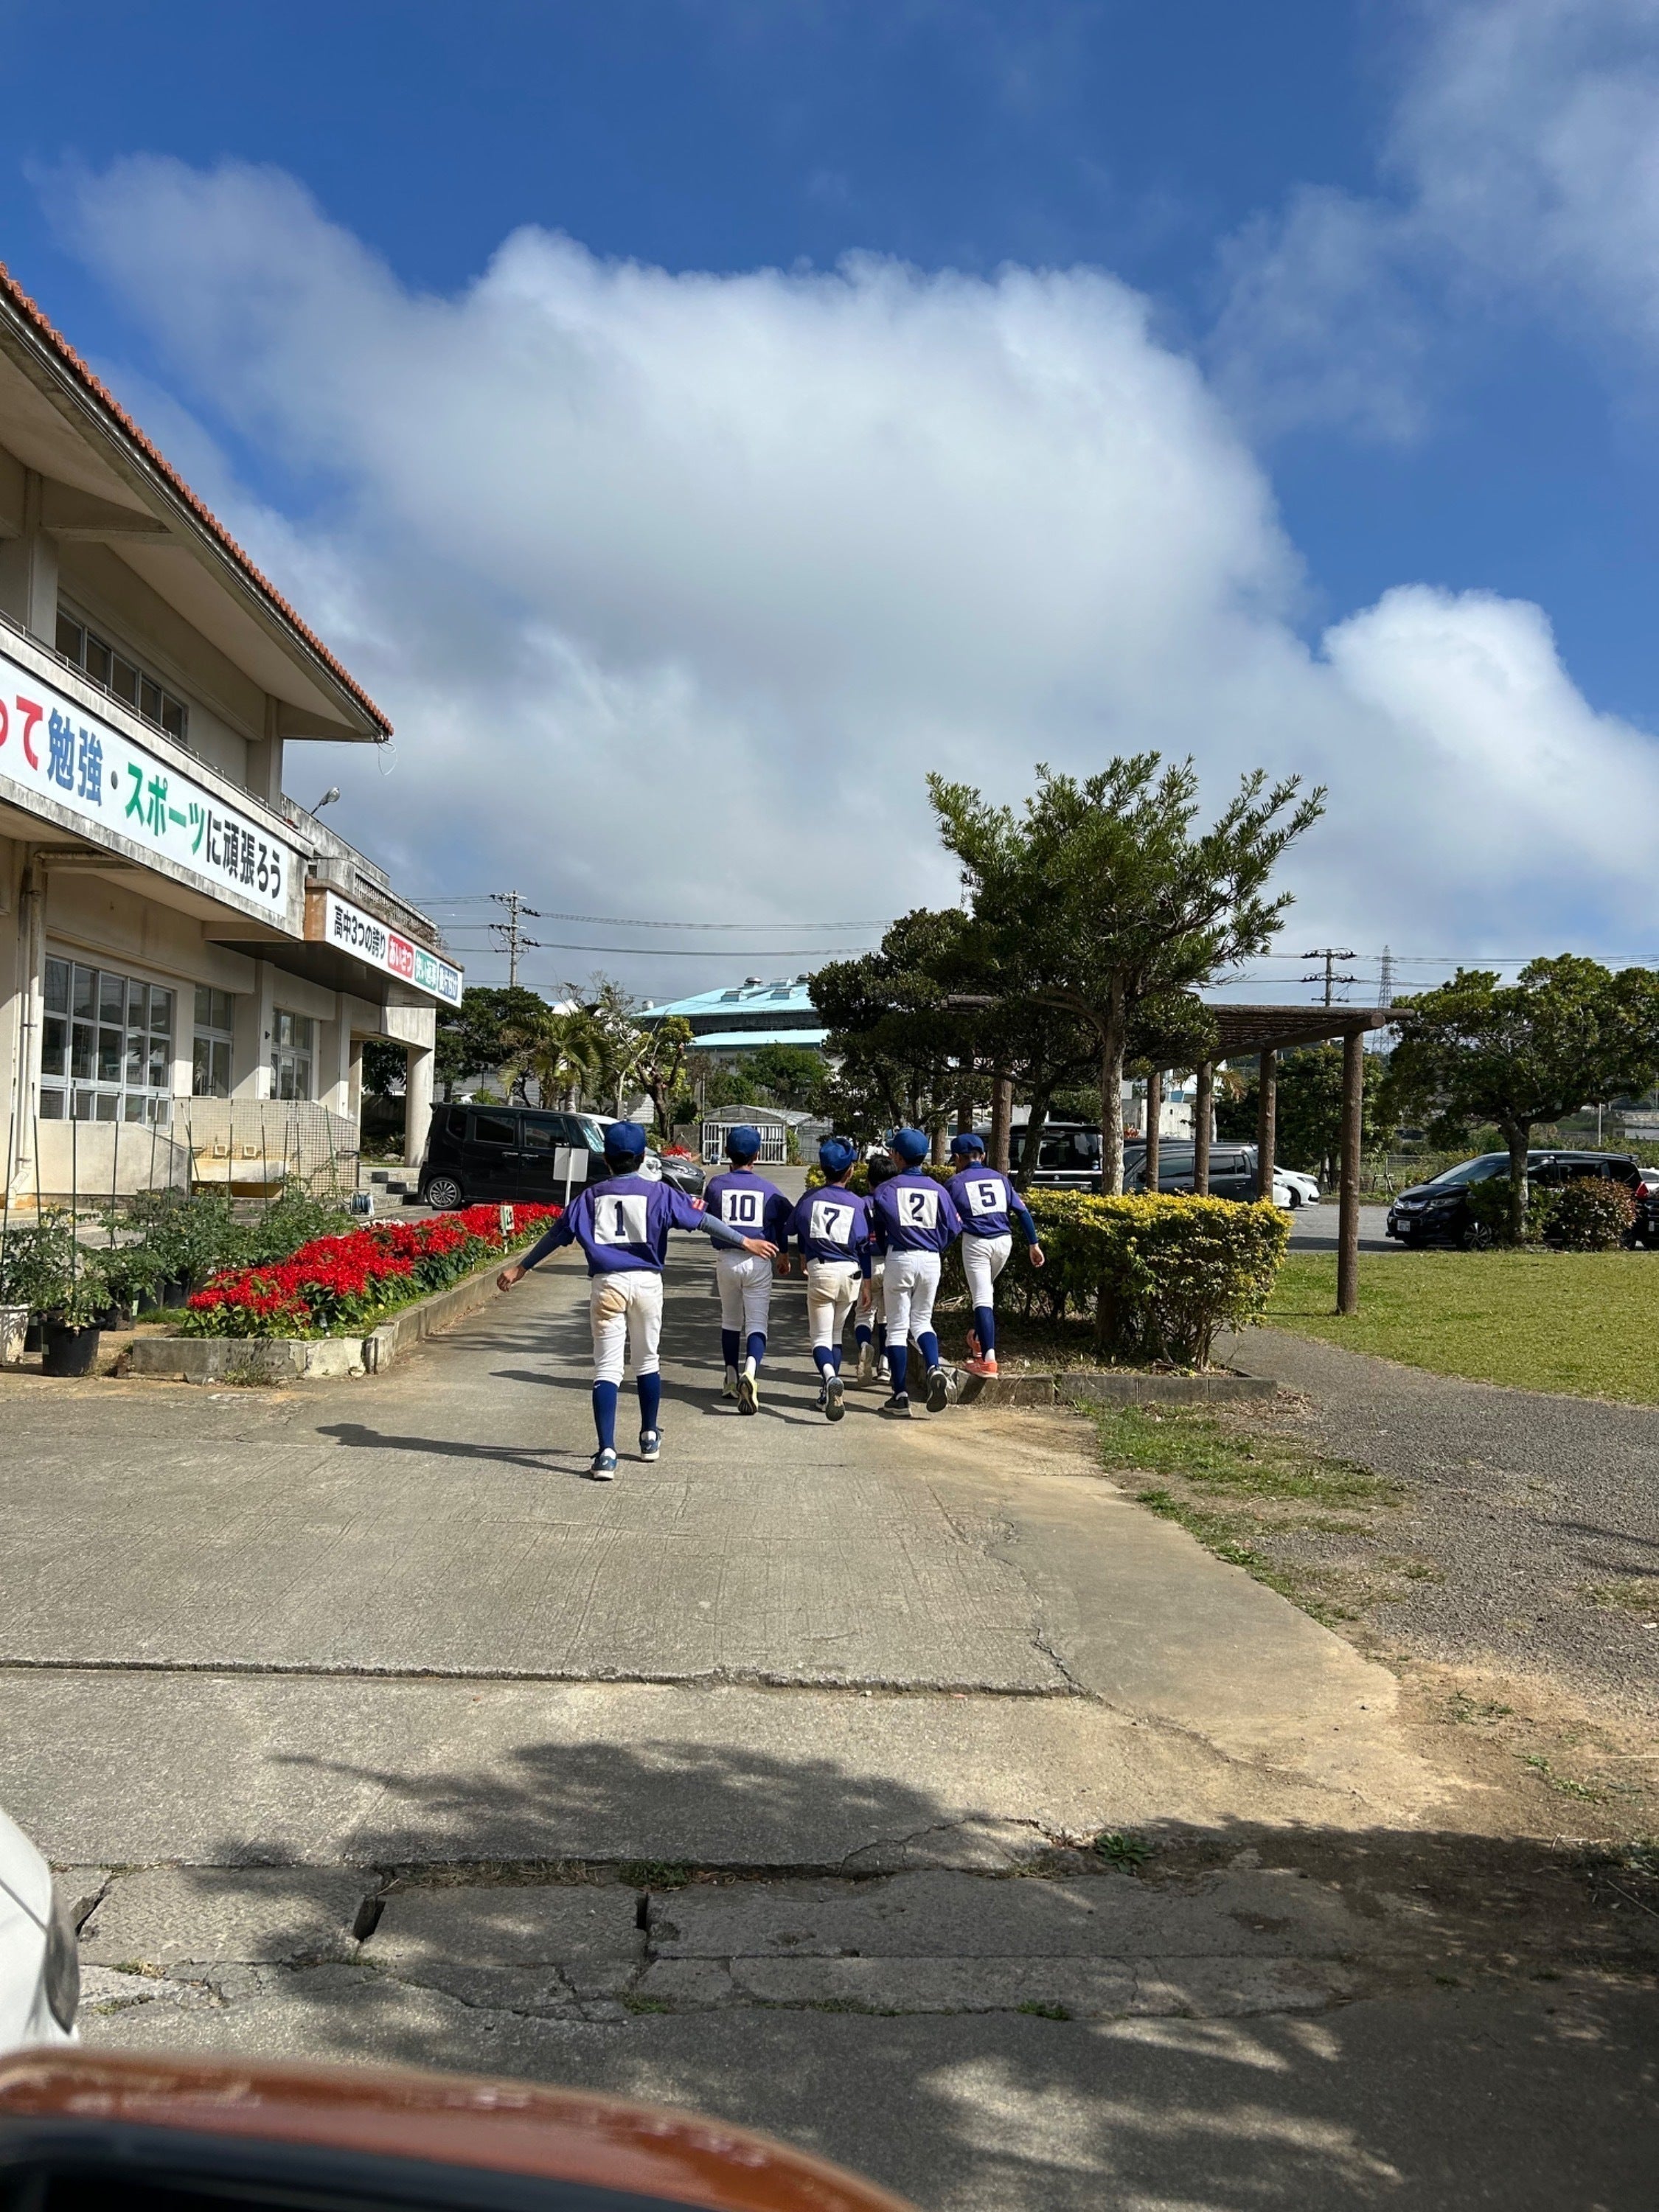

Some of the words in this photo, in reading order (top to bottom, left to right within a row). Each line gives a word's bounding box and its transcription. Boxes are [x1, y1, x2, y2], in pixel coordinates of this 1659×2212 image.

[334, 905, 386, 960] 高中3つの誇り
[389, 938, 412, 973] あいさつ
[730, 1195, 755, 1221] 10
[910, 1194, 924, 1222] 2
[978, 1184, 996, 1207] 5
[615, 1201, 625, 1236] 1
[824, 1208, 839, 1235] 7
